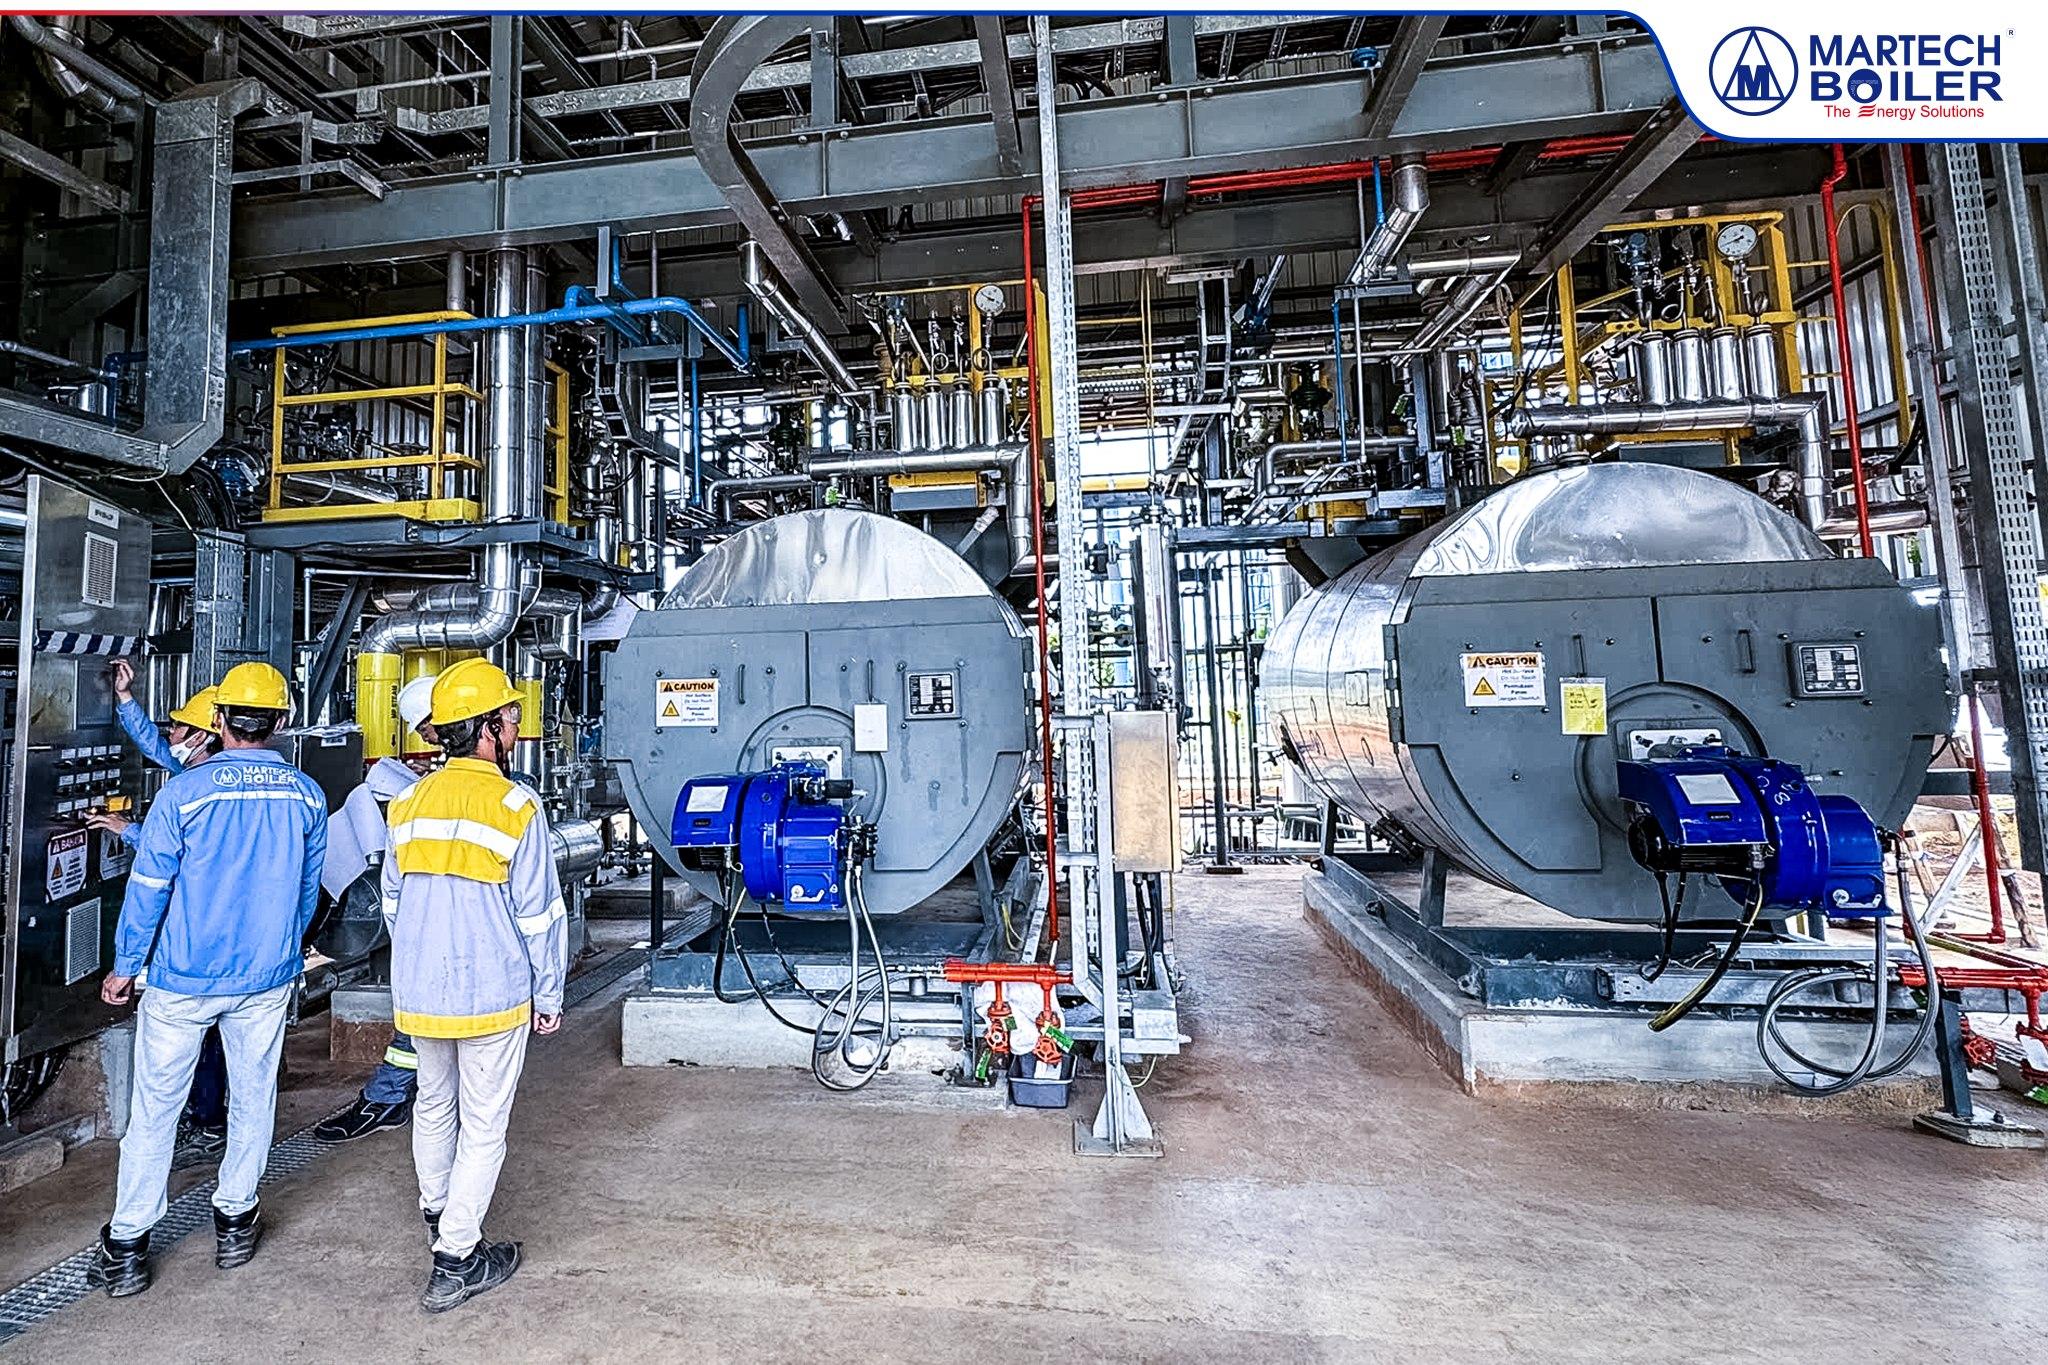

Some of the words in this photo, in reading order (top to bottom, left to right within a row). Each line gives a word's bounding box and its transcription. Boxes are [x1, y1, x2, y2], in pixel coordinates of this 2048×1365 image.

[1486, 657, 1536, 665] CAUTION
[674, 682, 714, 690] CAUTION
[243, 766, 295, 776] MARTECH
[243, 775, 297, 784] BOILER
